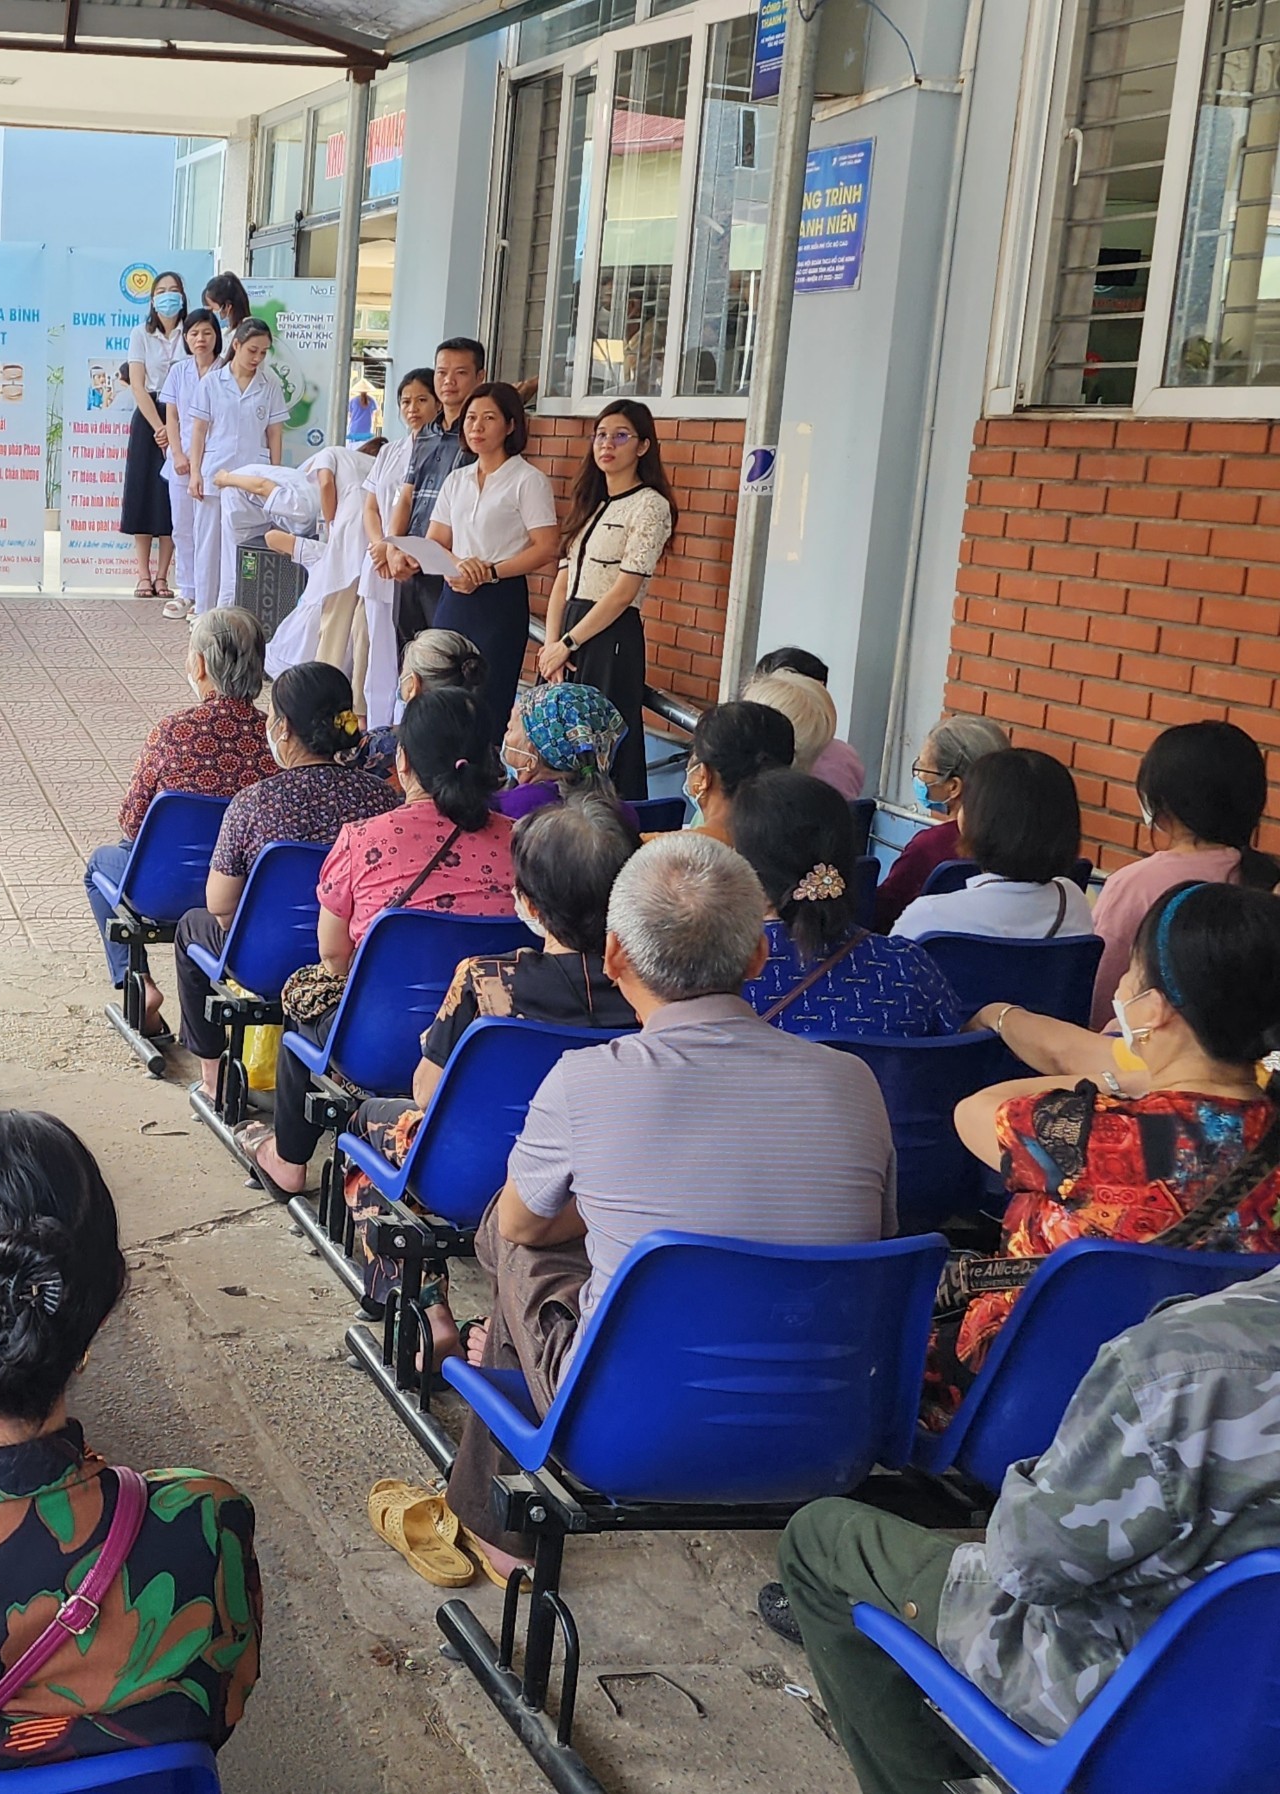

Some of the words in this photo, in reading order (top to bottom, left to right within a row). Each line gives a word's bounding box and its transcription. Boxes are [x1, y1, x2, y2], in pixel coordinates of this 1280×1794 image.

[802, 190, 822, 211] NG
[825, 181, 863, 208] TRÌNH
[800, 217, 824, 239] ANH
[826, 208, 858, 236] NIÊN
[10, 305, 40, 322] BÌNH
[73, 312, 106, 326] BVĐK
[111, 308, 140, 328] TỈNH
[278, 312, 301, 322] THỦY
[106, 337, 130, 350] KHO
[313, 340, 327, 349] TÍN
